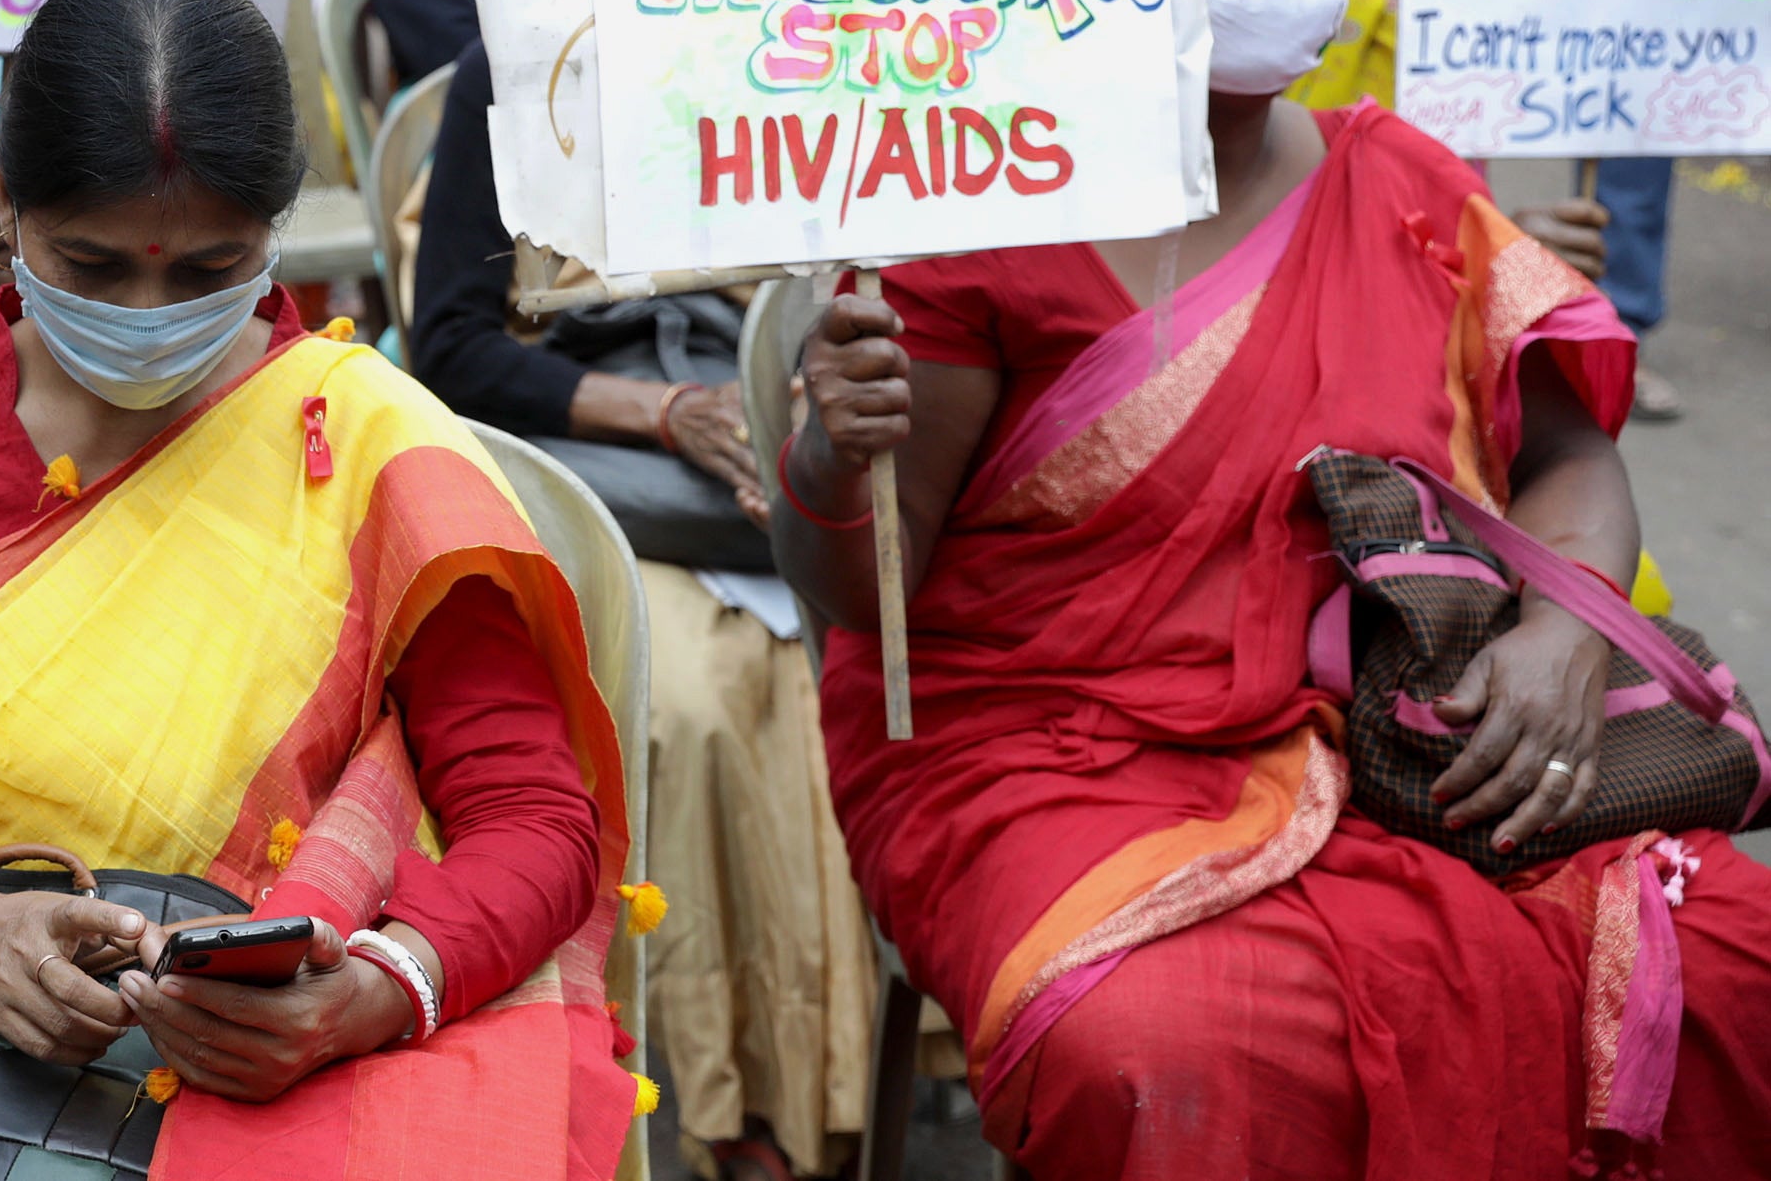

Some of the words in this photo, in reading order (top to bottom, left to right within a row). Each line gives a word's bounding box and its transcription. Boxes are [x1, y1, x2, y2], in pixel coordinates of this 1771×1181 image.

[746, 3, 1005, 95] STOP
[1409, 9, 1440, 75] I
[1556, 22, 1668, 71] make
[1672, 27, 1758, 74] you
[697, 97, 1075, 229] HIV/AIDS
